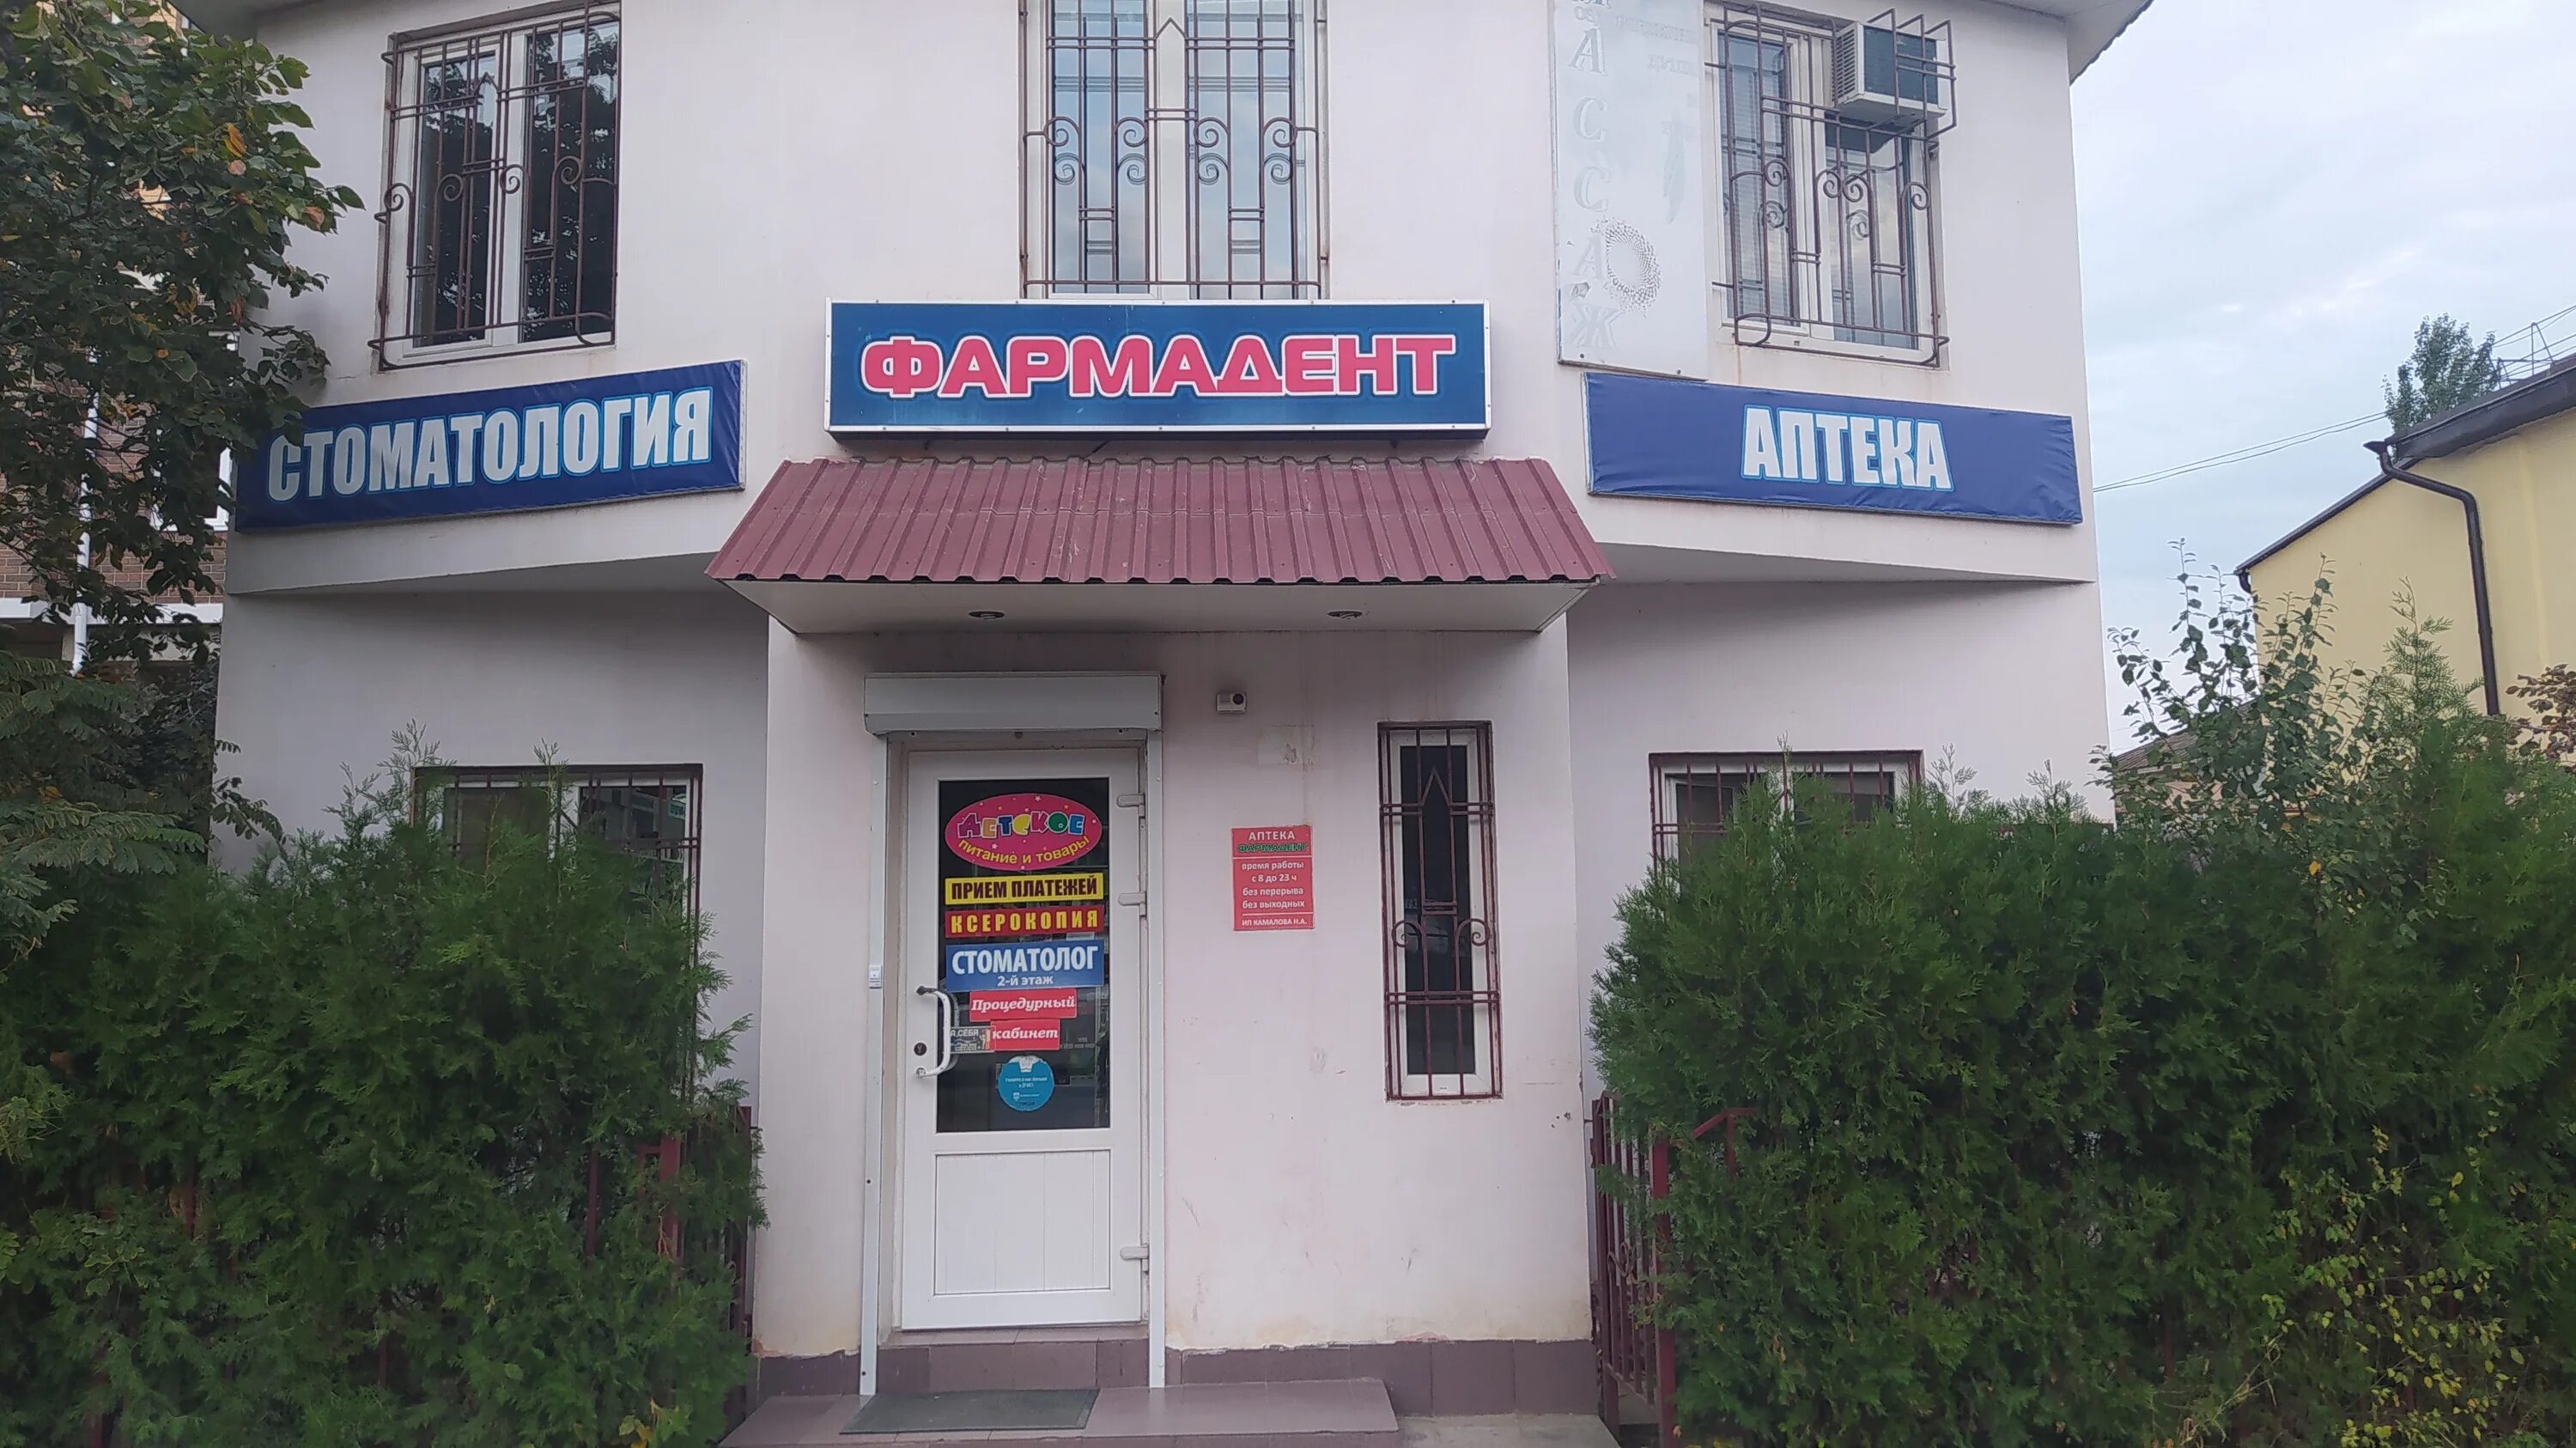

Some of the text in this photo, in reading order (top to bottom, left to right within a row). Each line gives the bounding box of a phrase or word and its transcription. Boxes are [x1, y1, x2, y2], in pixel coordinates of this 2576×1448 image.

[1566, 0, 1625, 347] АССАЖ
[860, 334, 1457, 399] ФАРМАДЕНТ
[267, 386, 714, 503] СТОМАТОЛОГИЯ
[1741, 405, 1955, 492] АПТЕКА
[957, 811, 1084, 839] ДЕТСКОЕ
[1249, 830, 1296, 841] АПТЕКА
[957, 837, 1090, 864] питание и товары
[1237, 843, 1308, 853] ФАРМАДЕНТ
[1242, 861, 1304, 871] время работы
[951, 874, 1097, 900] ПРИЕМ ПЛАТЕЖЕЙ
[1242, 887, 1303, 897] без перерыва
[1242, 900, 1305, 909] без выходных
[951, 910, 1098, 934] КСЕРОКОПИЯ
[951, 946, 1098, 975] СТОМАТОЛОГ
[997, 975, 1054, 987] 2-й этаж
[971, 996, 1076, 1013] Процедурный
[993, 1027, 1059, 1039] кабинет
